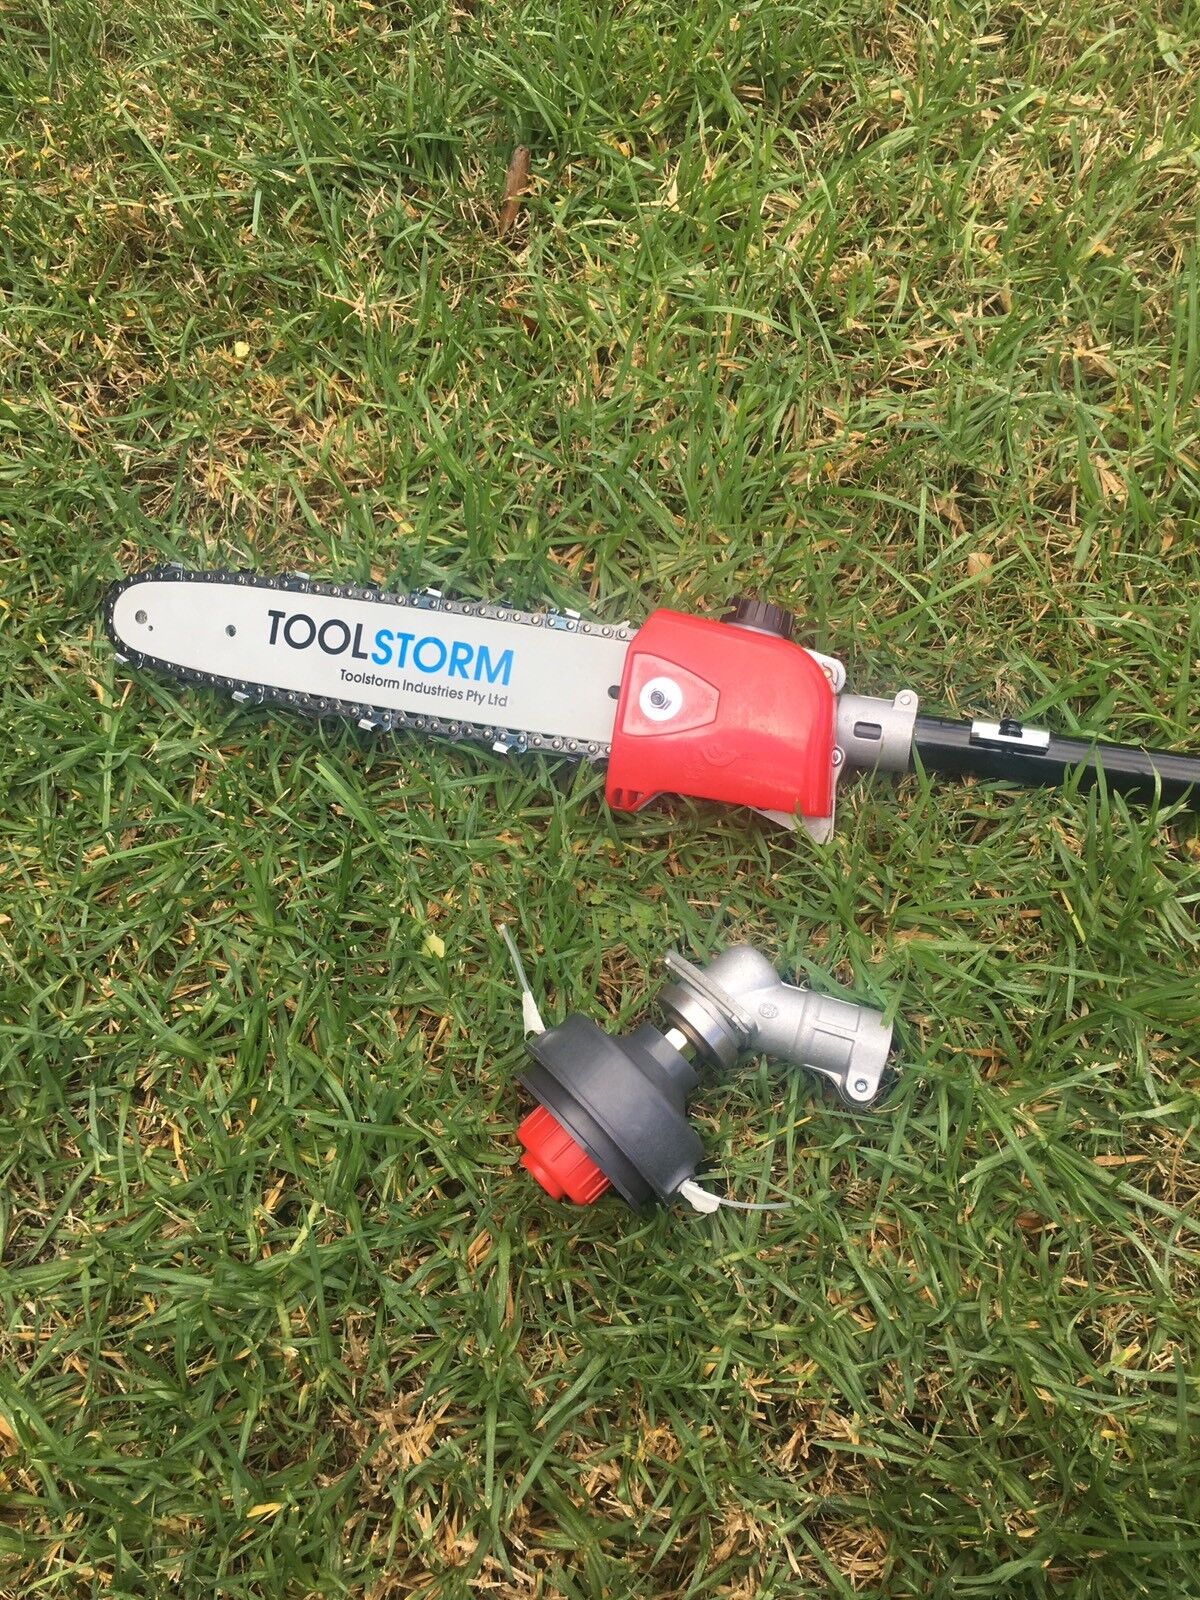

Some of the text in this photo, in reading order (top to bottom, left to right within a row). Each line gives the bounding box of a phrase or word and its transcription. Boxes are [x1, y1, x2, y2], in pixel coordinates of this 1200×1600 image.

[268, 609, 514, 686] TOOLSTORM
[340, 669, 508, 707] Toolstorm Industries Pty Ltd
